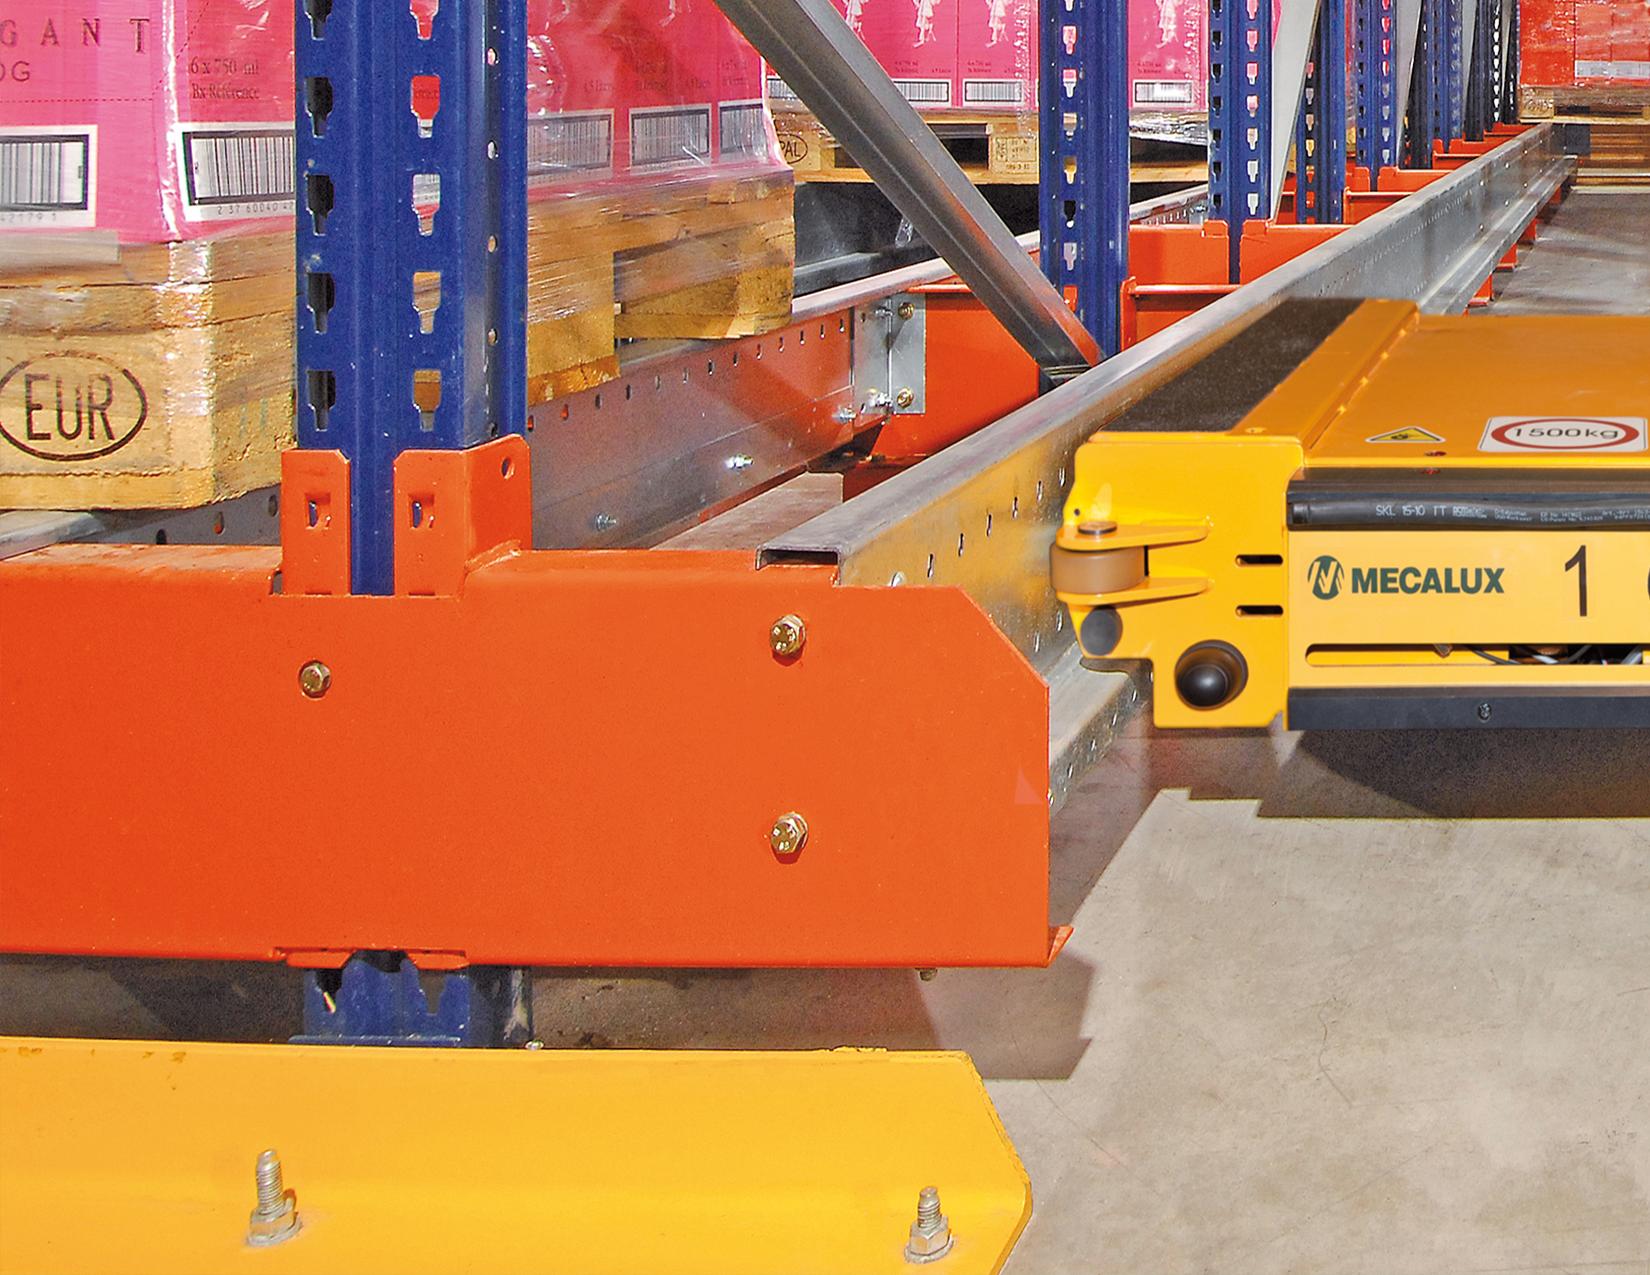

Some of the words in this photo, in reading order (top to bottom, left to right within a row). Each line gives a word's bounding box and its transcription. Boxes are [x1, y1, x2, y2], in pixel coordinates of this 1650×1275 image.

[26, 374, 115, 441] EUR
[1375, 505, 1396, 517] SKL
[1402, 505, 1426, 517] 15-10
[1351, 566, 1505, 595] MECALUX
[1564, 544, 1588, 617] 1
